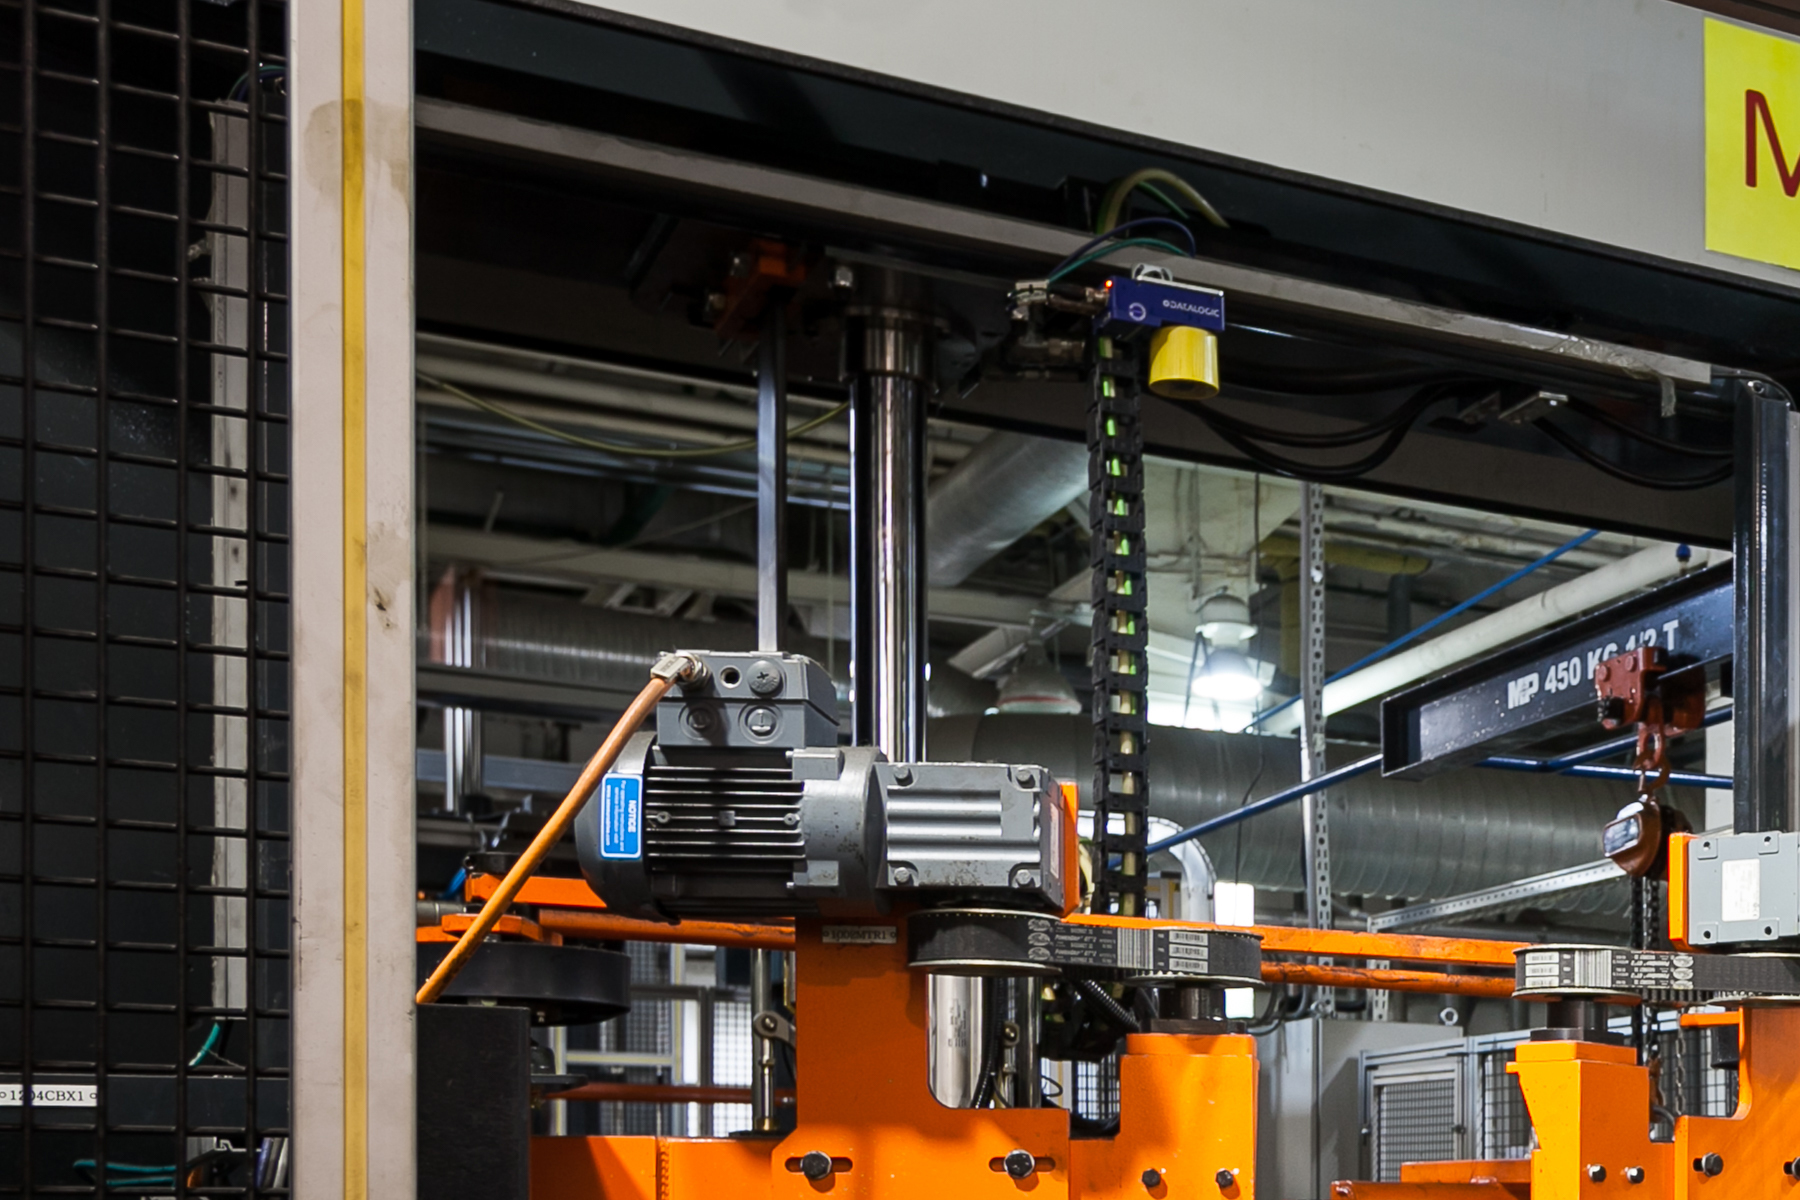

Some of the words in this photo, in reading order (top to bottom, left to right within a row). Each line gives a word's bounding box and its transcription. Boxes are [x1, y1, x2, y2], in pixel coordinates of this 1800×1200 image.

[1169, 301, 1220, 318] DATALOGIC
[1544, 656, 1582, 694] 450
[1662, 619, 1679, 651] T
[627, 800, 636, 833] NOTICE
